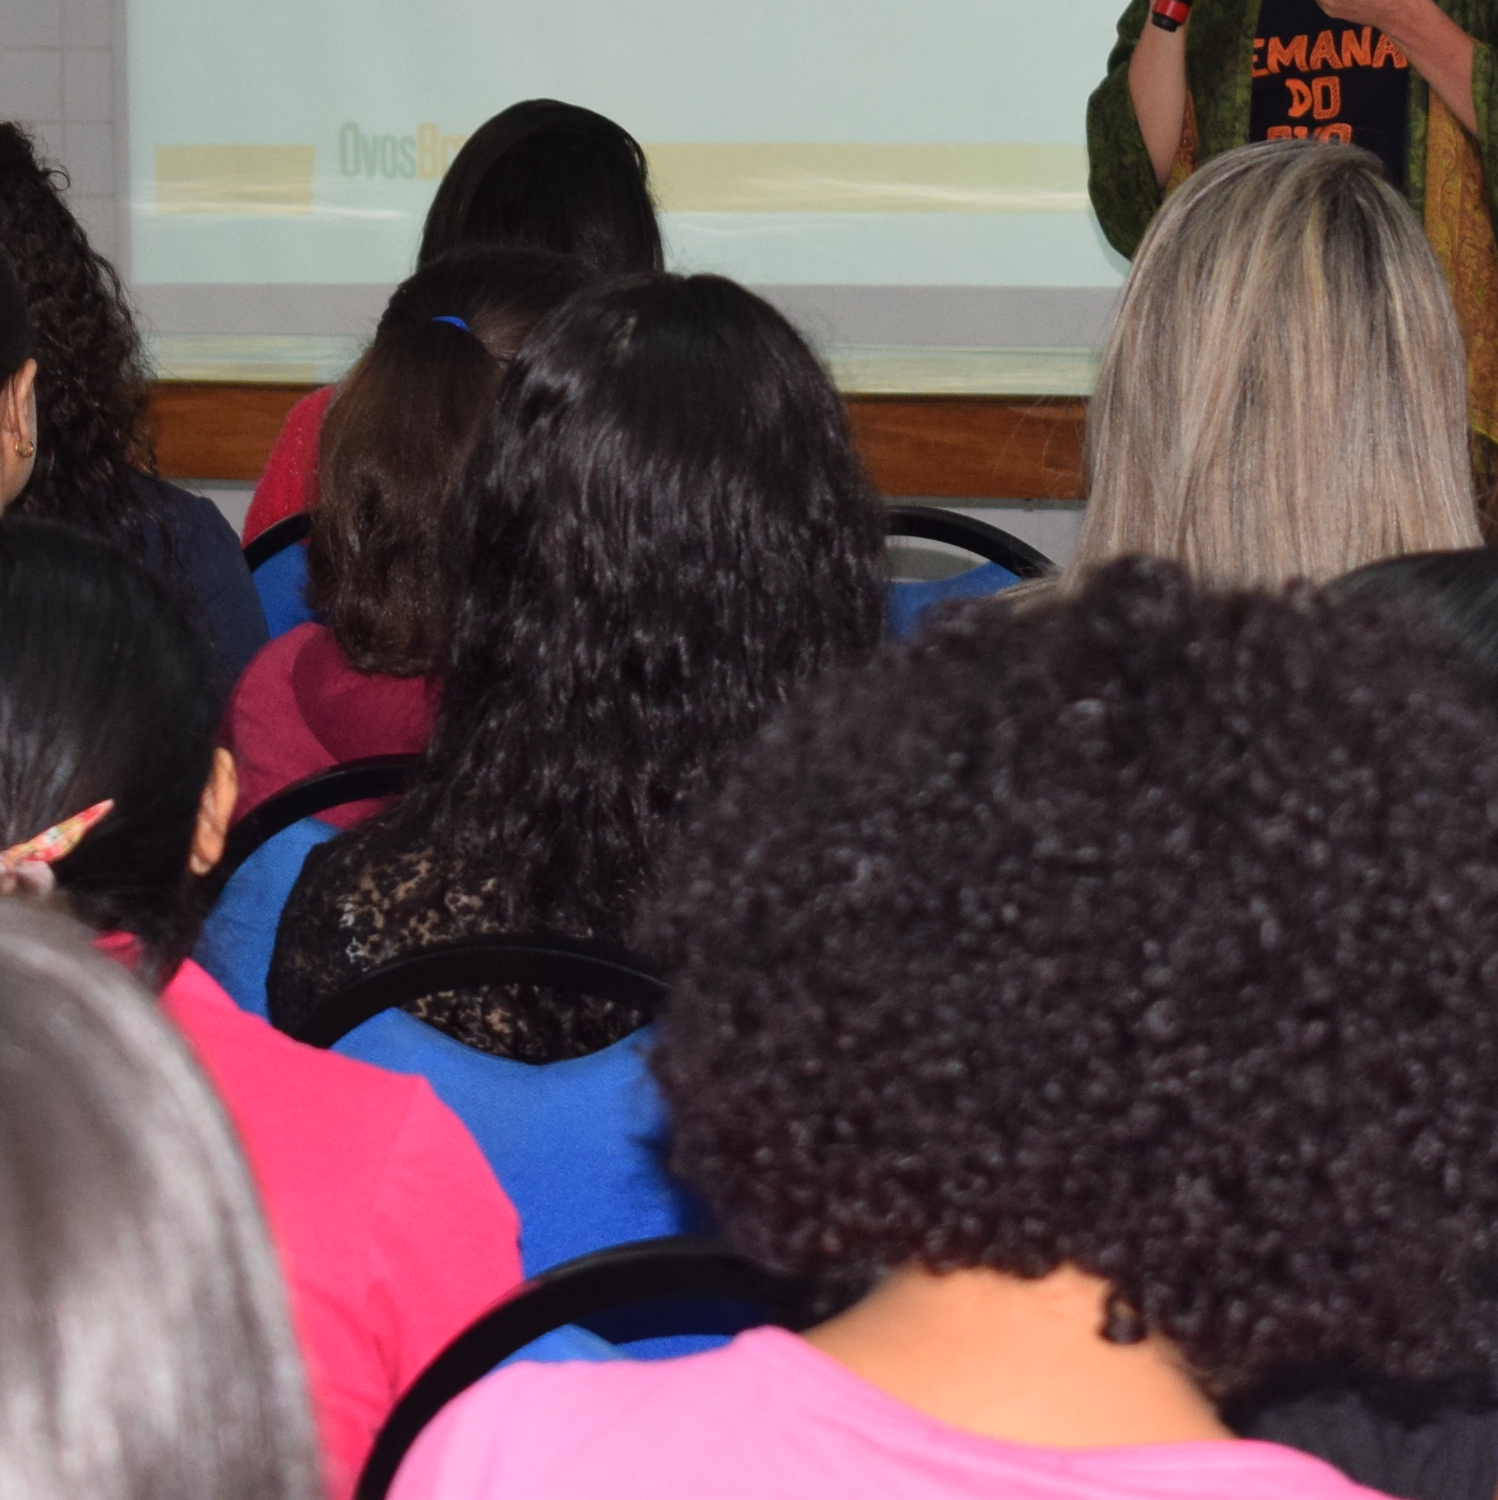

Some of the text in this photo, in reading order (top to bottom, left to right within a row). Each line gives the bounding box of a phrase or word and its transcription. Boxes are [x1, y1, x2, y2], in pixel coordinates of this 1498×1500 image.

[1251, 26, 1409, 77] EMANA
[1285, 76, 1341, 120] DO
[338, 121, 469, 180] OvosBr
